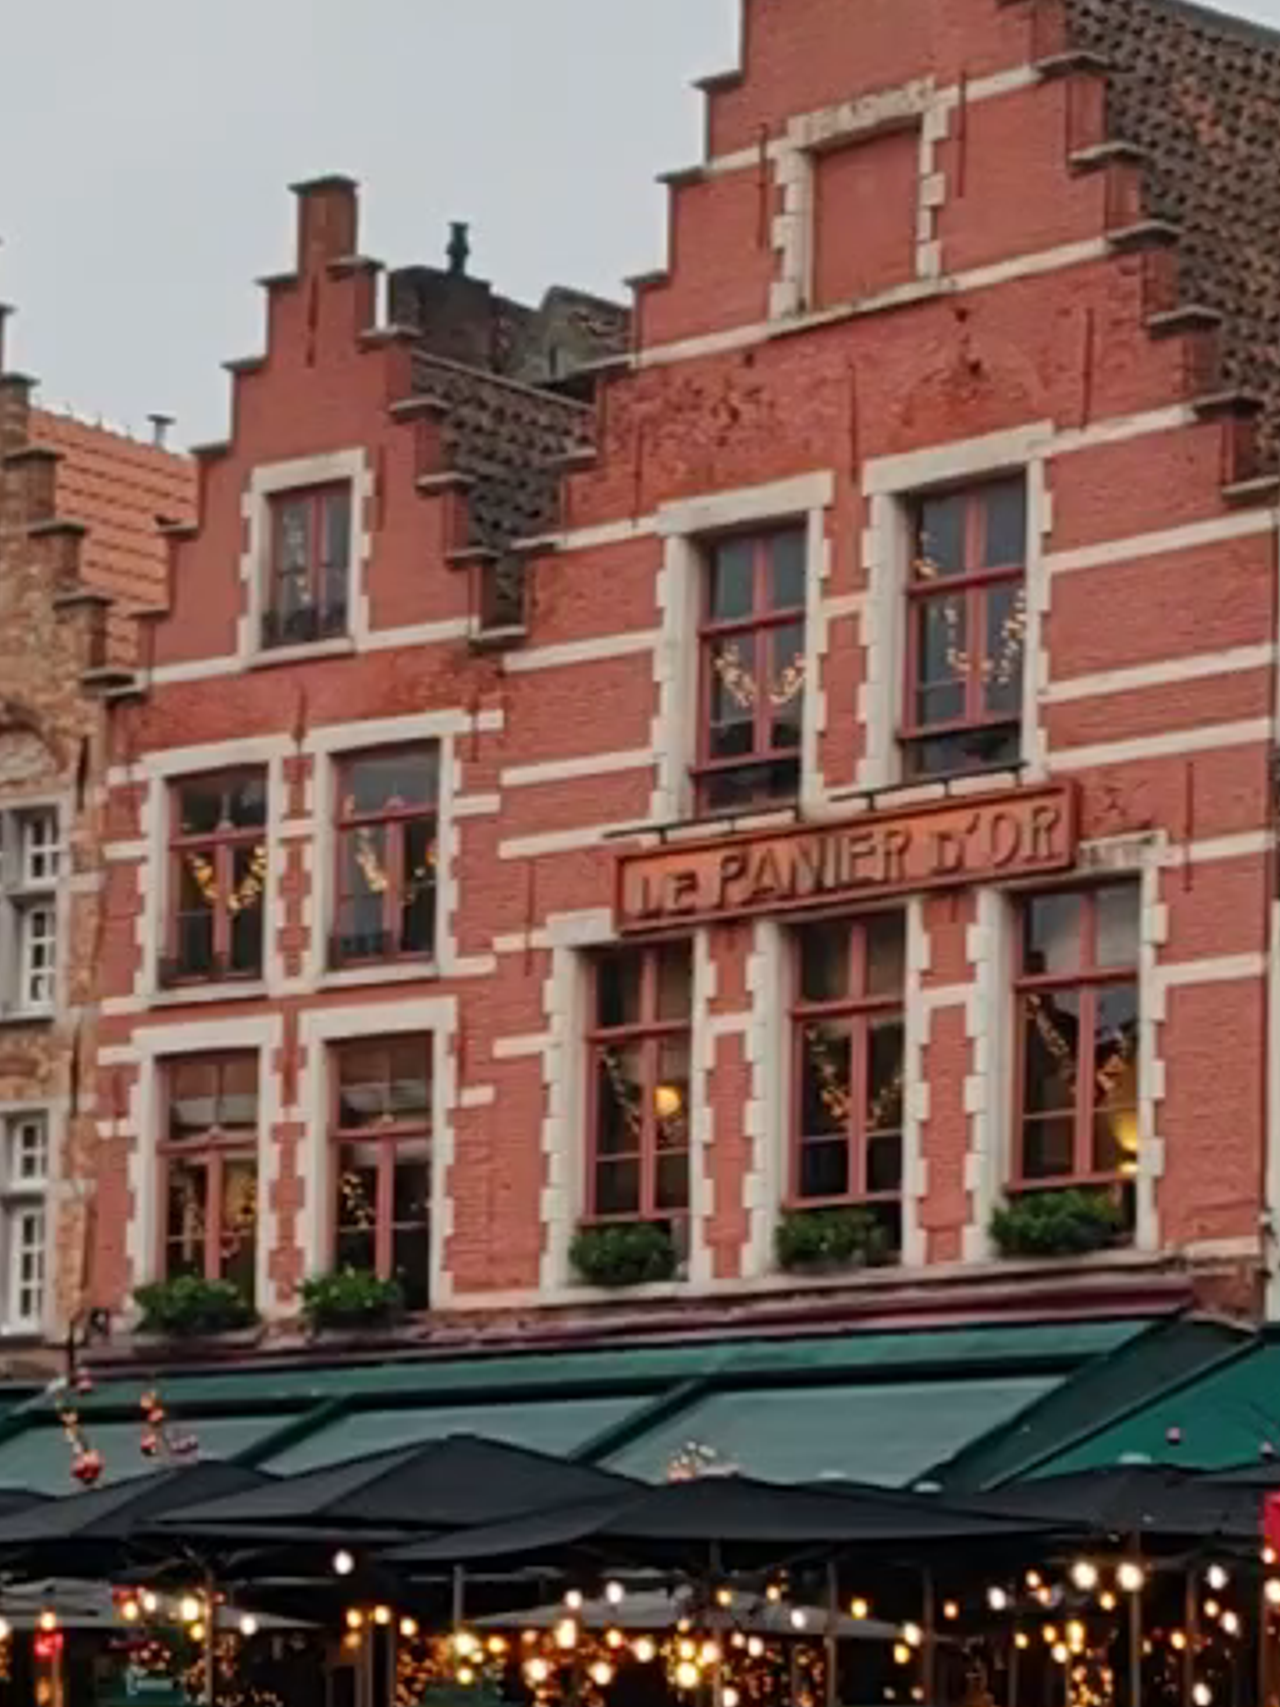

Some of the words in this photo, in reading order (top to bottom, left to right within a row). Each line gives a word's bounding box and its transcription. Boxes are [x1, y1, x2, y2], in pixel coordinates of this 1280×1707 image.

[635, 869, 698, 920] LE
[720, 828, 913, 909] PANIER
[929, 803, 1063, 875] D'OR
